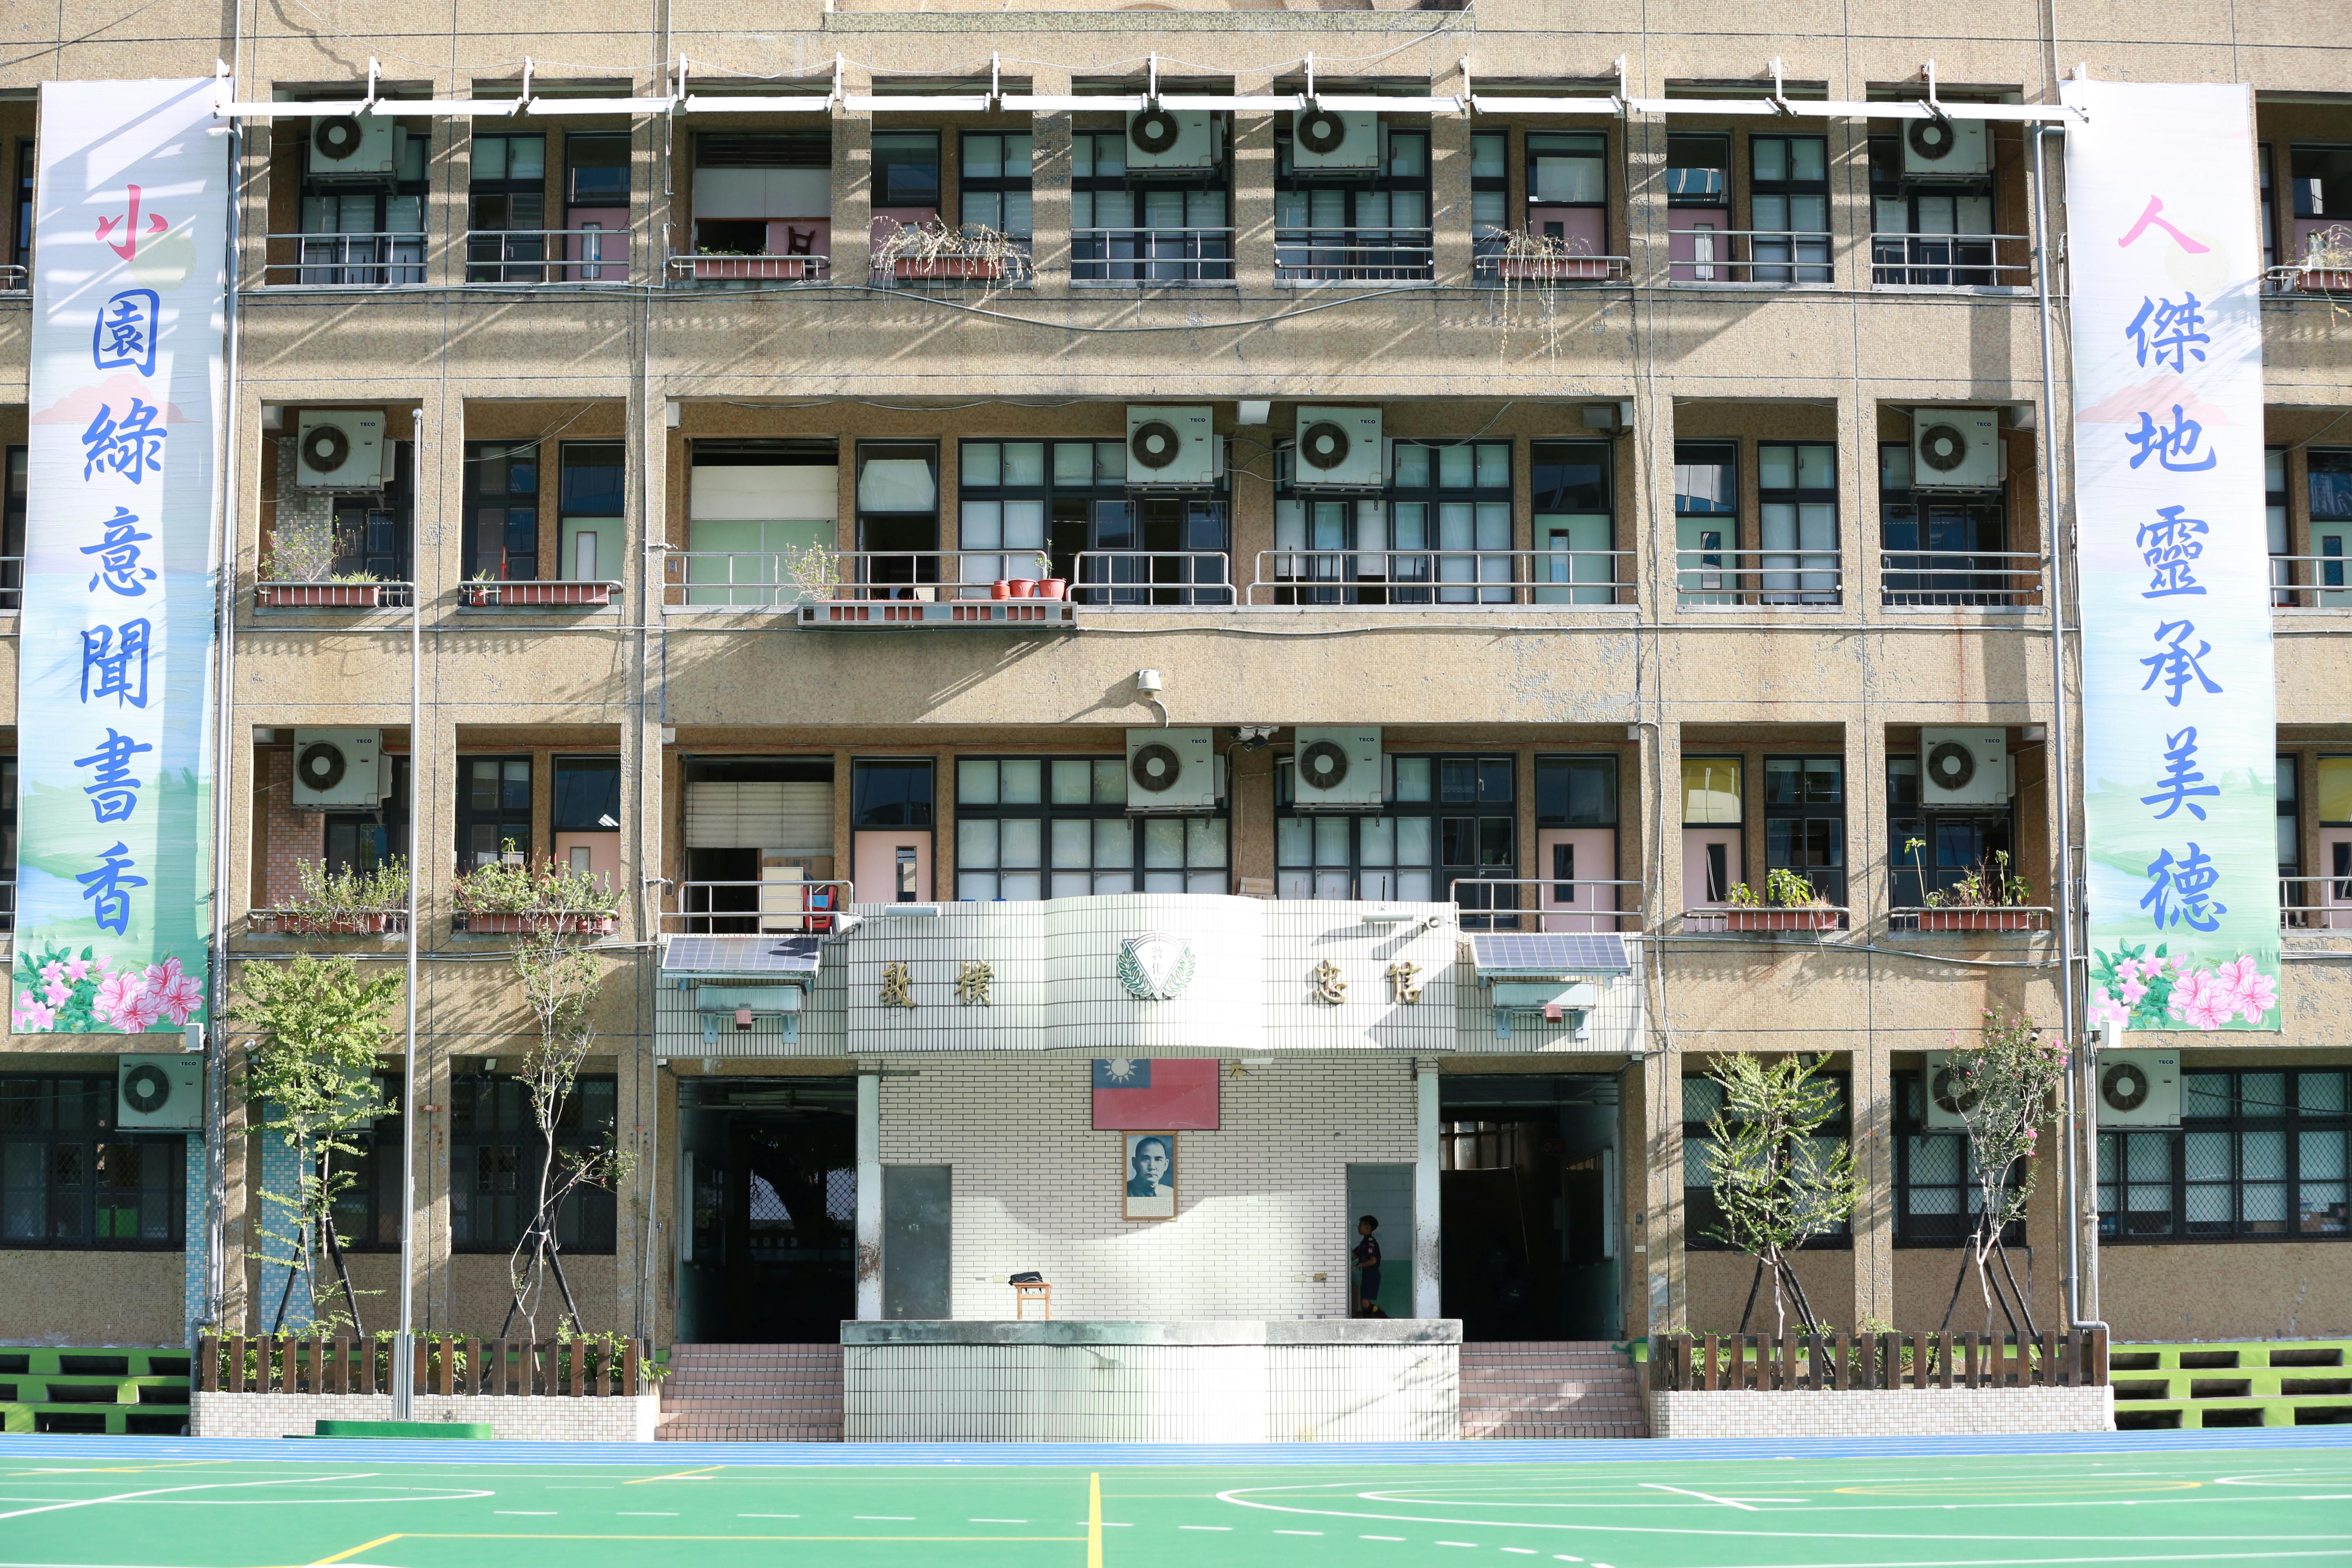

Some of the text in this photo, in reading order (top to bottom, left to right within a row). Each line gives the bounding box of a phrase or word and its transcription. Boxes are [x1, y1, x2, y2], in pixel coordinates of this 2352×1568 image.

[75, 184, 168, 936] 小園綠意聞書香
[2118, 194, 2227, 932] 人傑地靈承美德
